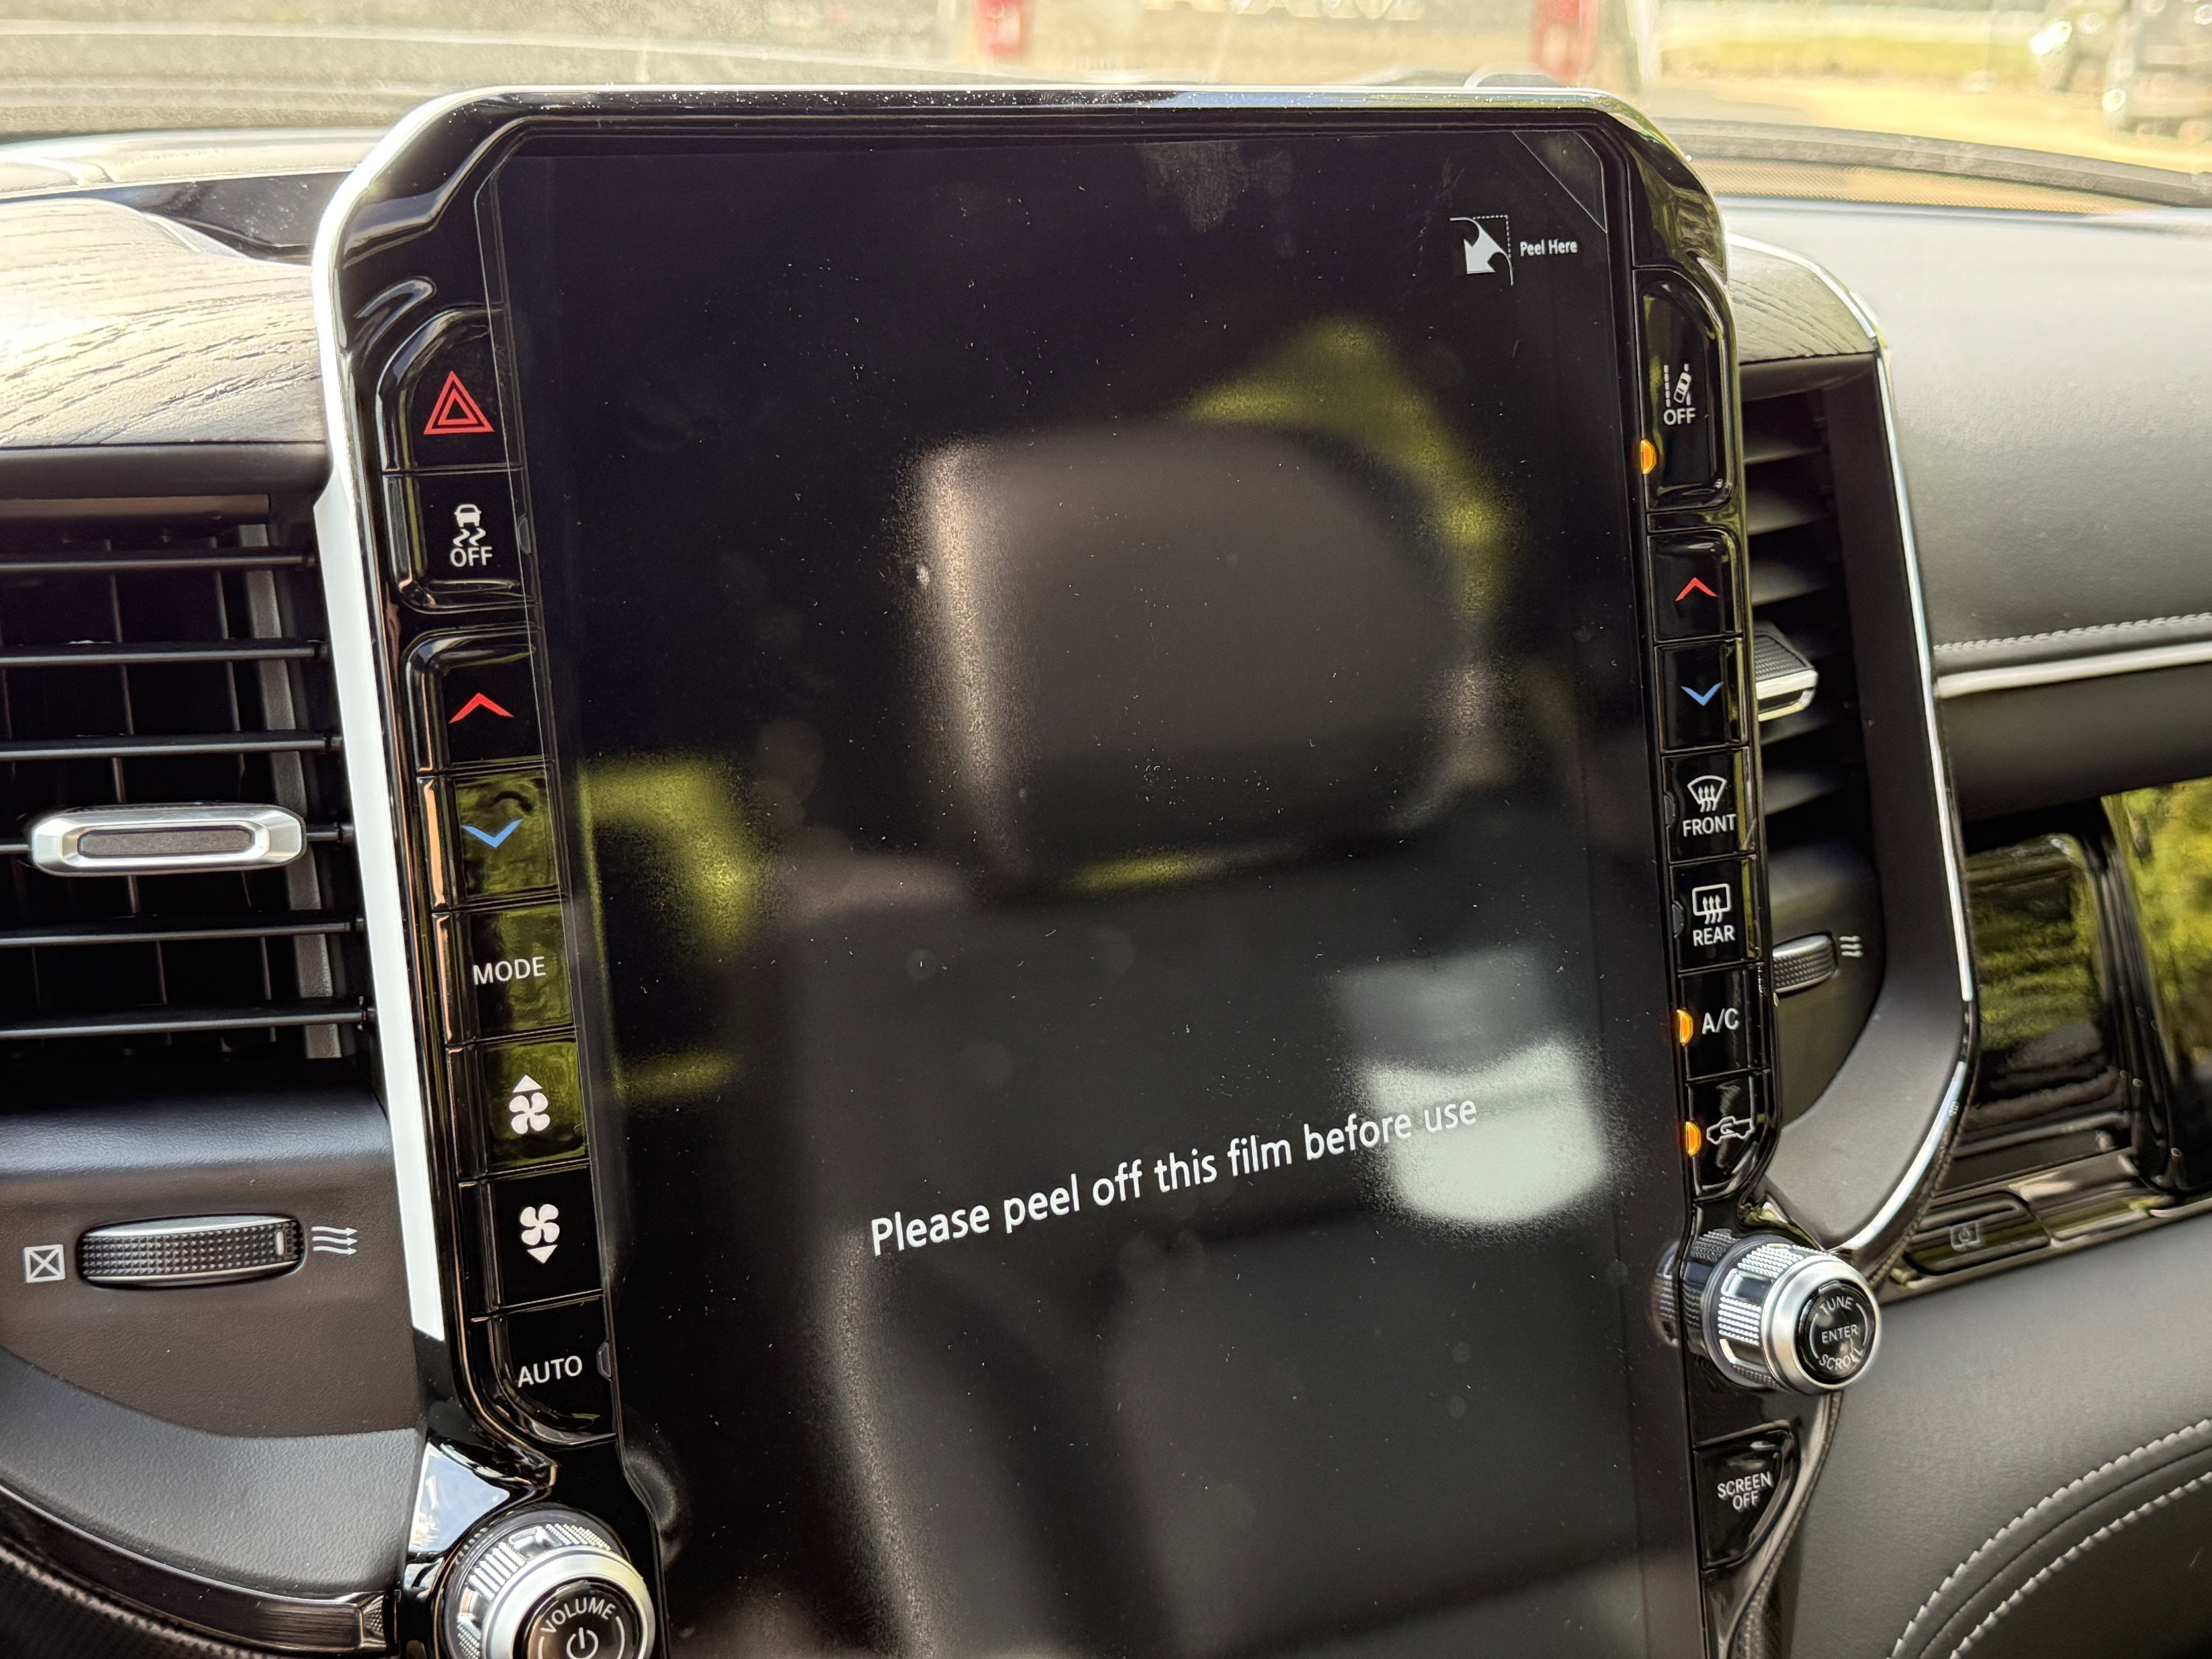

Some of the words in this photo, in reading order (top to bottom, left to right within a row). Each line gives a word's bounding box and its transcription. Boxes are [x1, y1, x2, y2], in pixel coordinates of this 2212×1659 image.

[1520, 240, 1545, 257] Peel
[1548, 239, 1578, 255] Here
[1663, 407, 1696, 426] OFF
[450, 546, 493, 568] OFF
[1683, 813, 1736, 838] FRONT
[1692, 924, 1735, 946] REAR
[472, 956, 546, 985] MODE
[1702, 1007, 1739, 1035] A/C
[870, 1205, 991, 1257] Please
[1003, 1173, 1080, 1234] peel
[1091, 1158, 1144, 1207] off
[1154, 1149, 1218, 1194] this
[1226, 1133, 1292, 1178] film
[1303, 1110, 1412, 1160] before
[1424, 1098, 1477, 1135] use
[1819, 1295, 1854, 1315] TUNE
[1821, 1324, 1860, 1345] ENTER
[1819, 1348, 1864, 1371] SCROLL
[517, 1355, 583, 1388] AUTO
[1717, 1471, 1774, 1500] SCREEN
[1732, 1490, 1760, 1512] OFF
[540, 1596, 616, 1634] VOLUME
